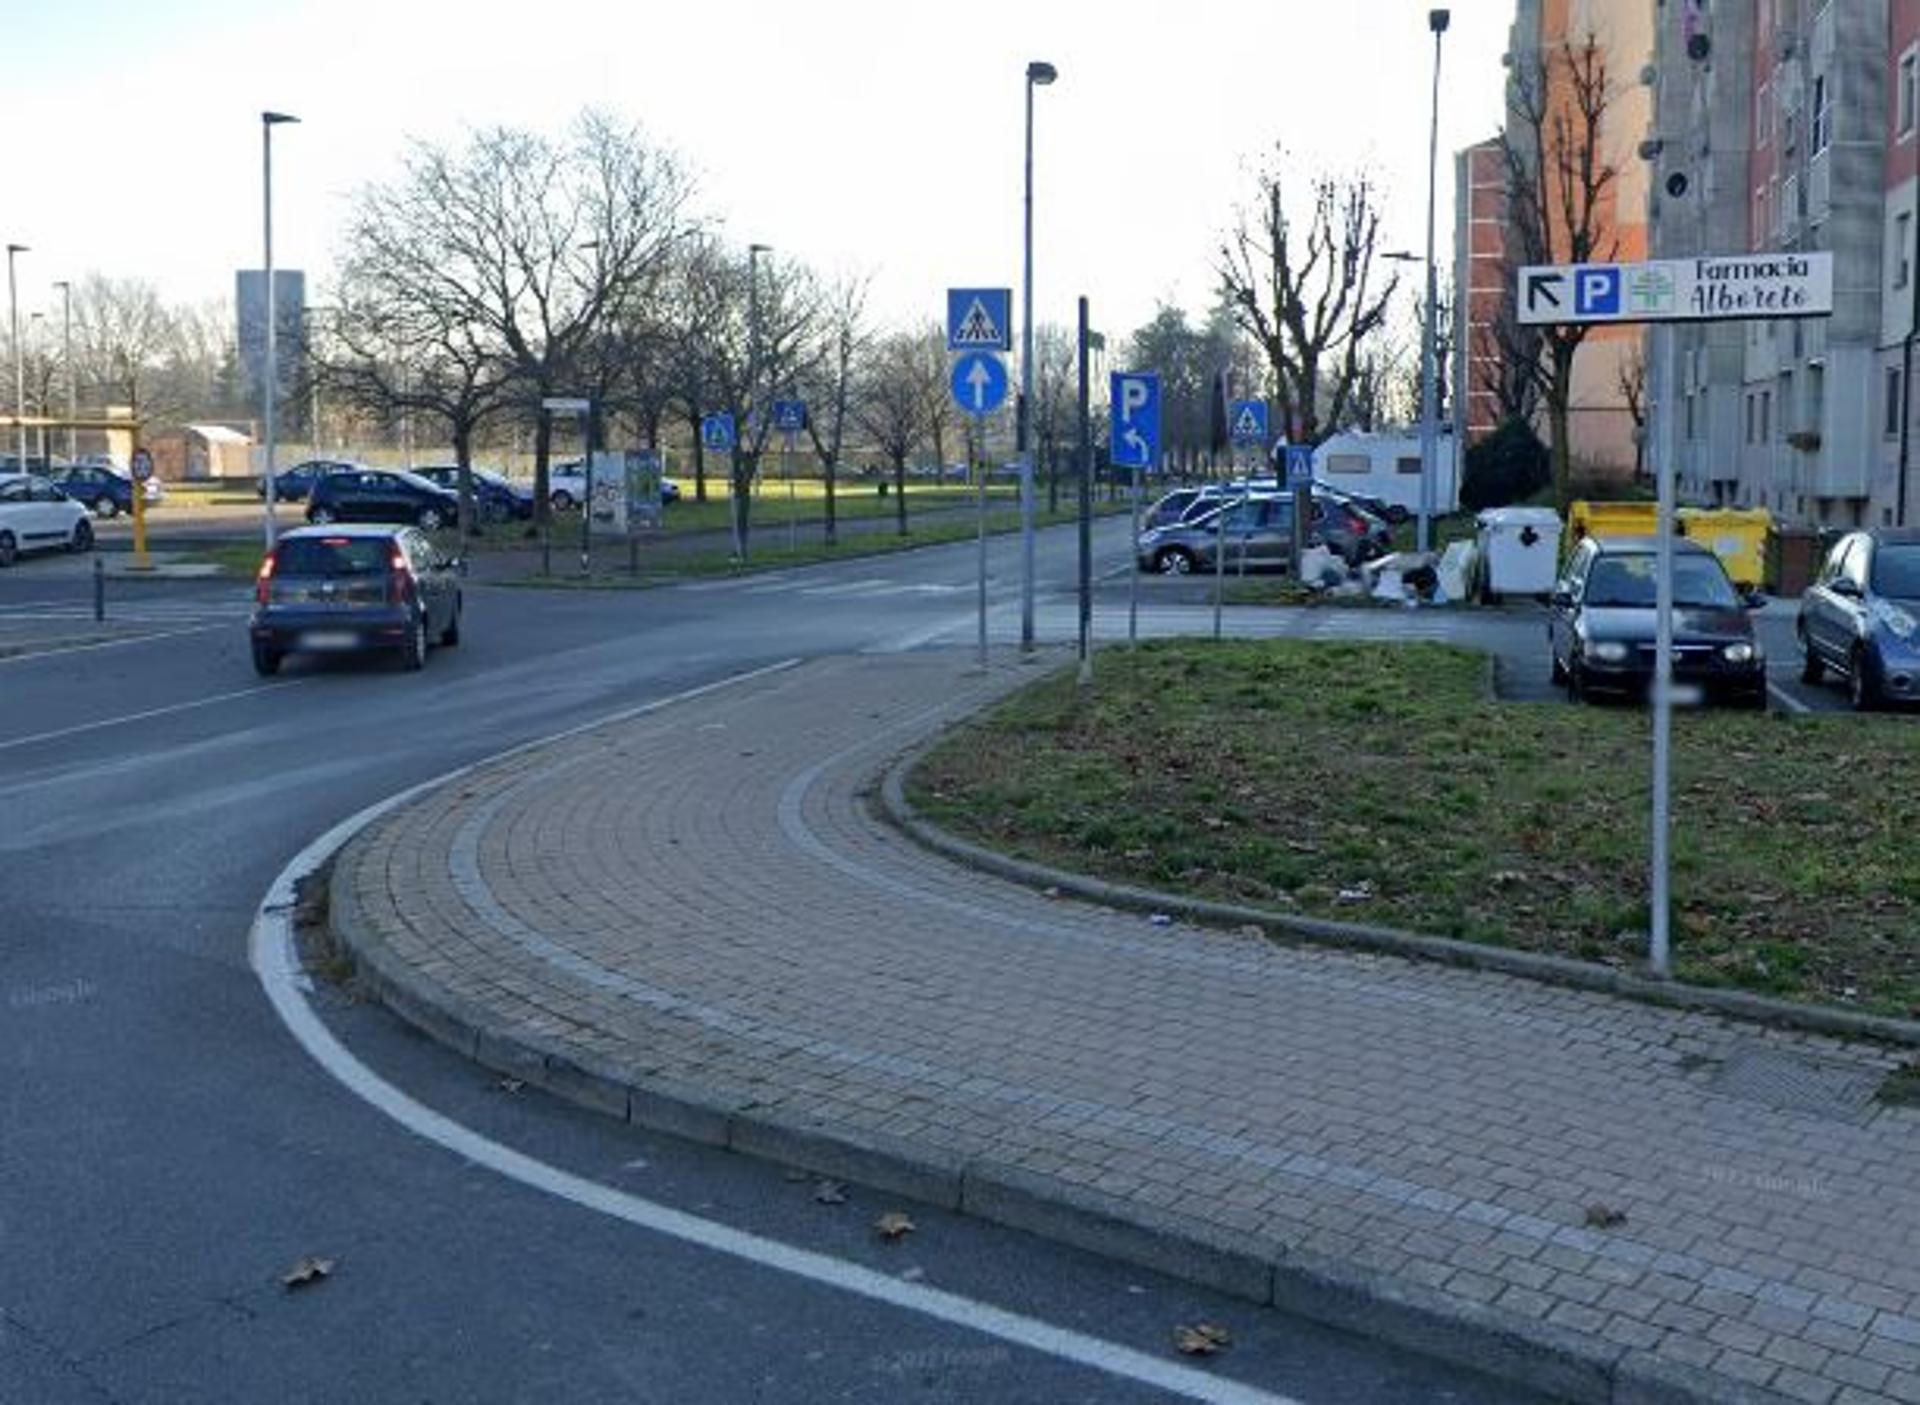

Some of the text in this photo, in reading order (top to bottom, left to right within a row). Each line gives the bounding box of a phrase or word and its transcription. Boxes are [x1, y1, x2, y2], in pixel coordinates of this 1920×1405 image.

[1696, 256, 1808, 280] Farmacia
[1584, 275, 1611, 310] P
[1122, 379, 1148, 422] P
